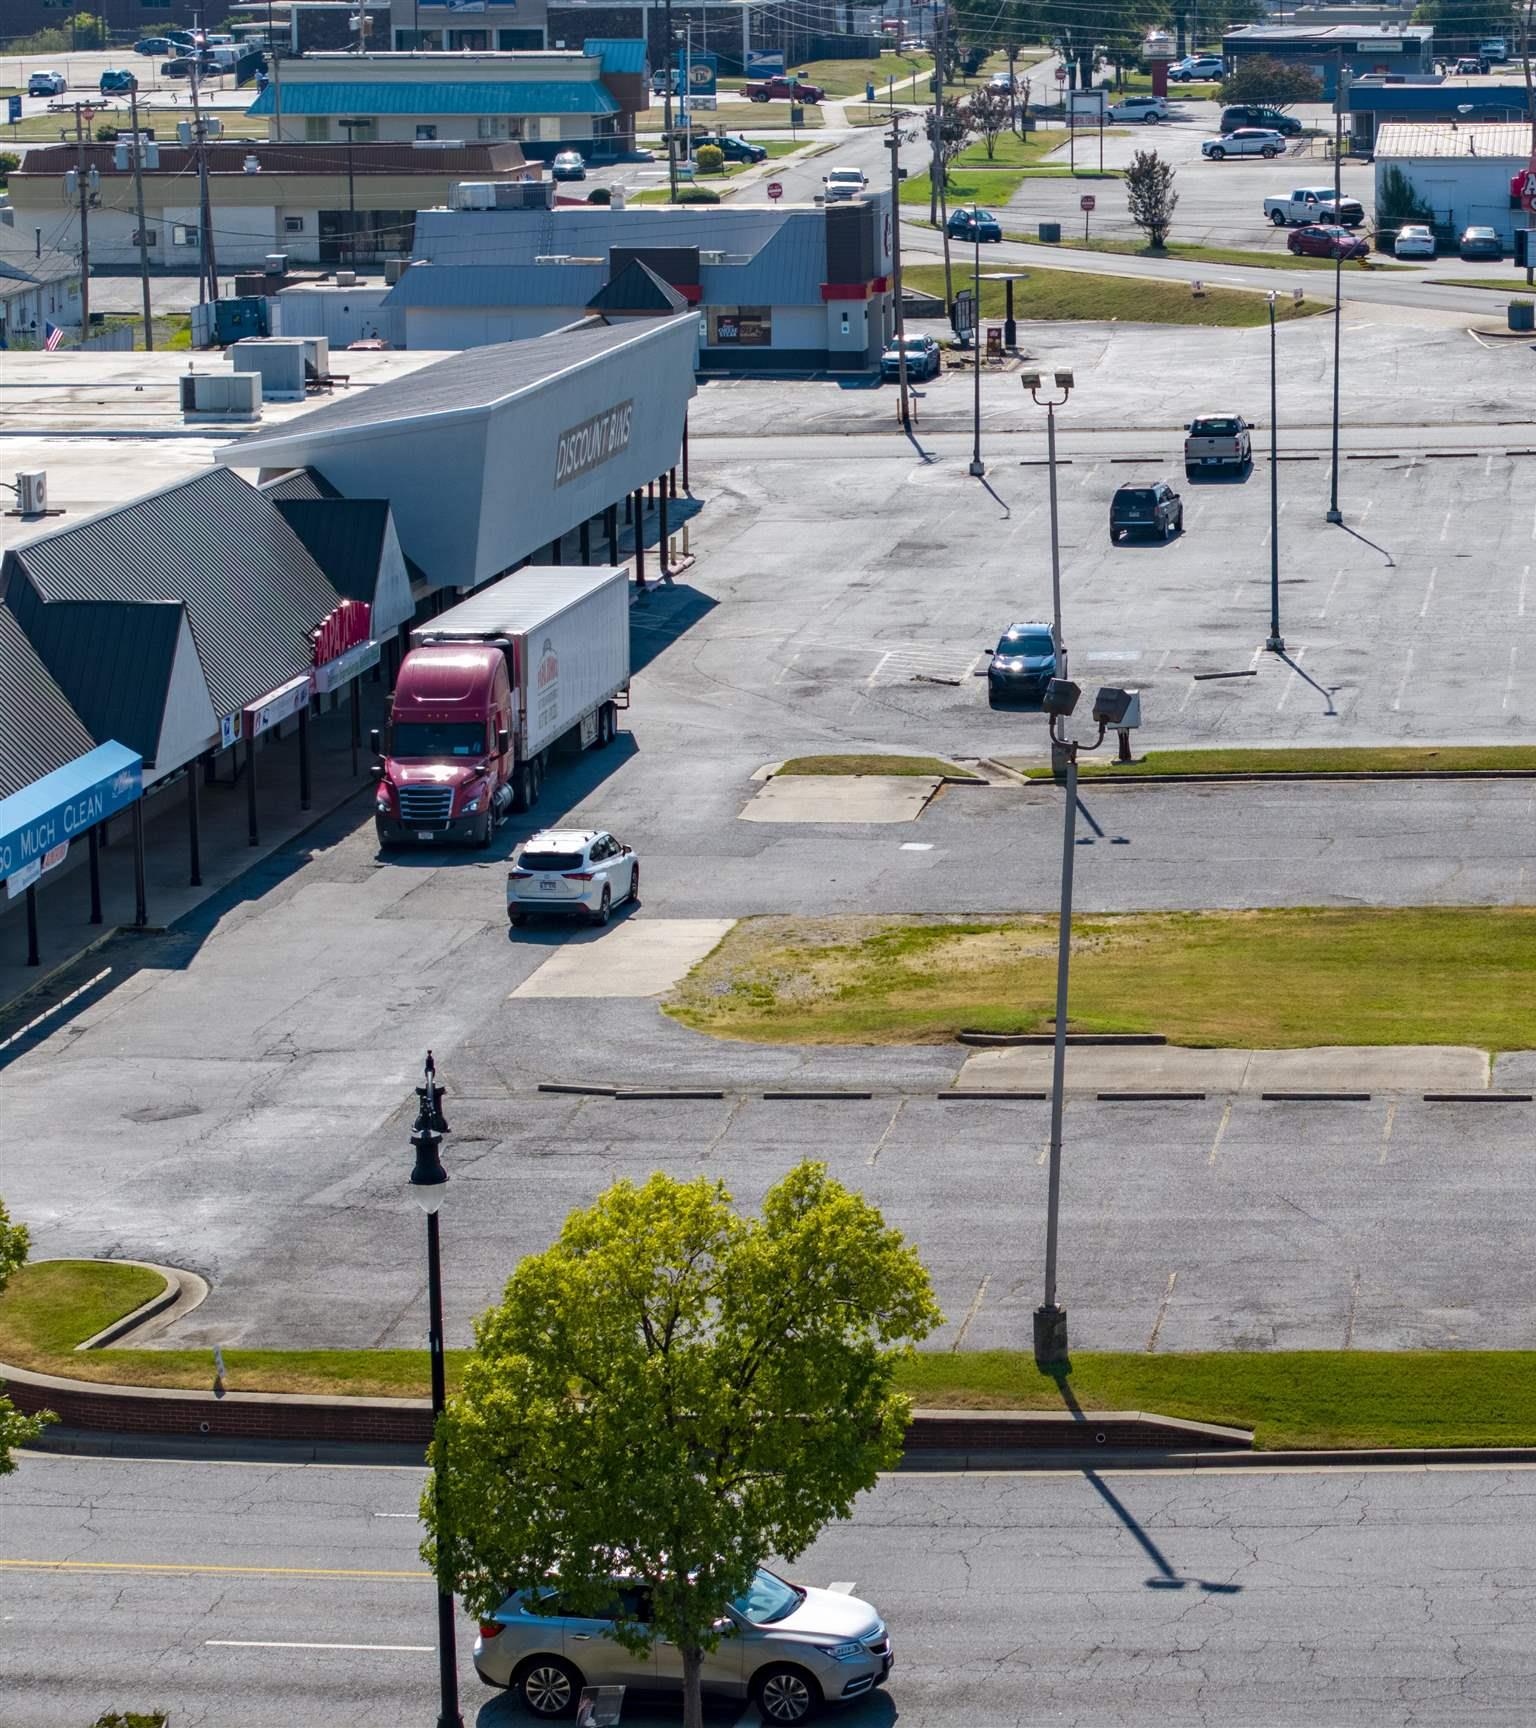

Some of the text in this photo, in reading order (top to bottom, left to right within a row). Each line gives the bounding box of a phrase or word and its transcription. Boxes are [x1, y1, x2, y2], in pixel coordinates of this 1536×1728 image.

[556, 405, 632, 480] DISCOUNT BINS
[21, 820, 55, 860] MUCH
[64, 792, 103, 833] CLEAN
